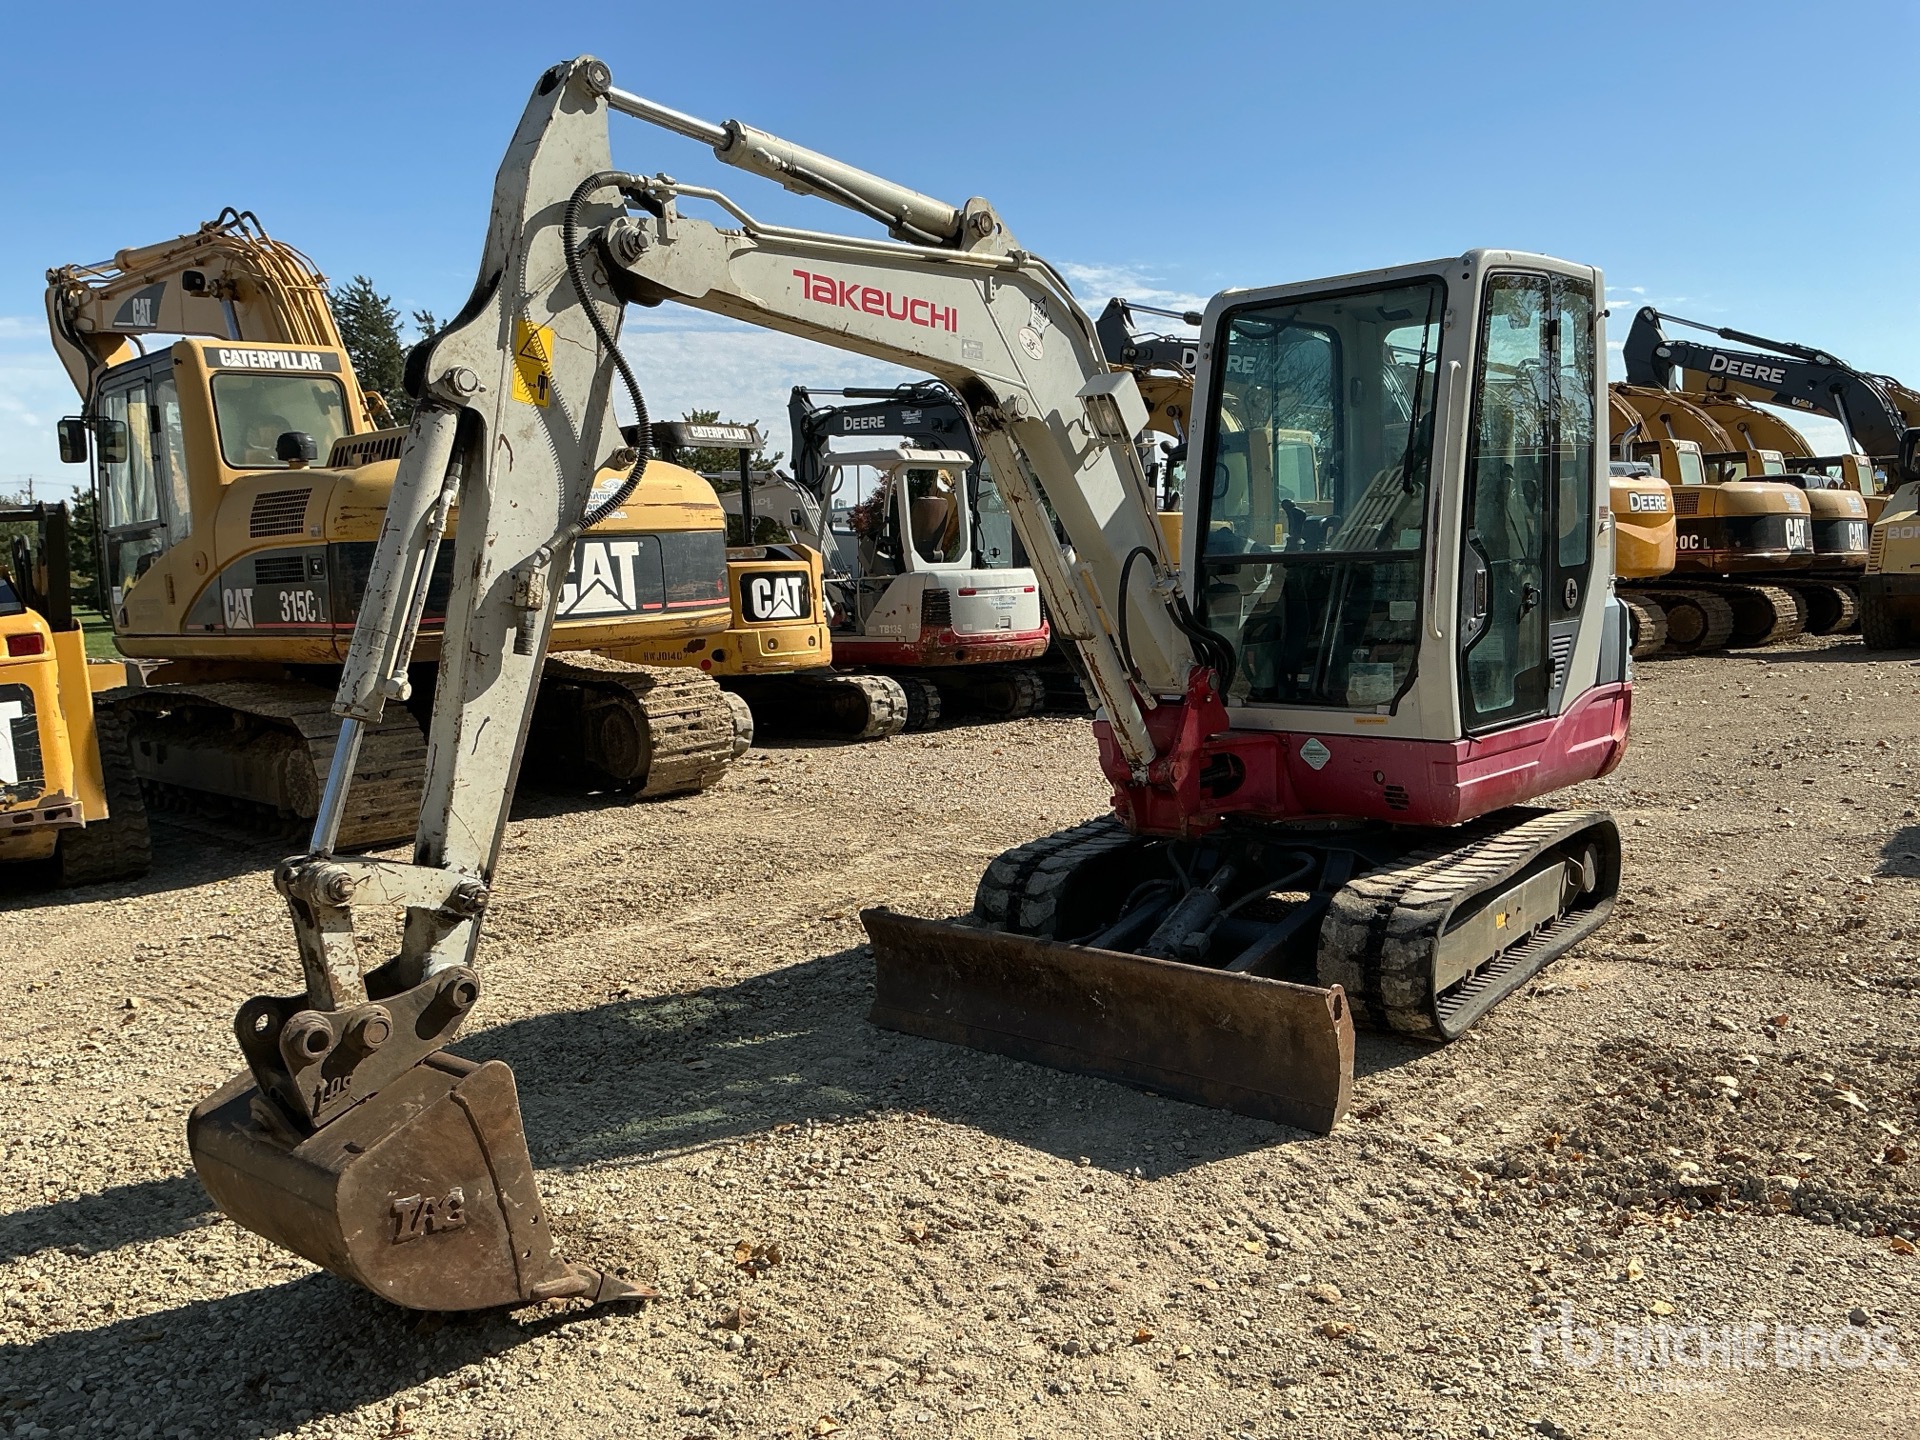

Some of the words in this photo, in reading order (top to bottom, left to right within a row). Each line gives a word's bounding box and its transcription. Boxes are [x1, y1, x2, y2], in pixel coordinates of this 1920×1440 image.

[132, 298, 151, 326] CAT
[219, 349, 323, 370] CATERPILLAR
[1182, 347, 1256, 373] DRE
[1709, 353, 1786, 384] DEERE
[691, 426, 746, 440] CATERPILLAR
[843, 416, 885, 430] DEERE
[1629, 492, 1667, 511] DEERE
[1785, 518, 1806, 550] CAT
[1848, 522, 1864, 550] CAT
[224, 588, 255, 628] CAT
[280, 589, 317, 622] 315C
[752, 577, 802, 618] CAT
